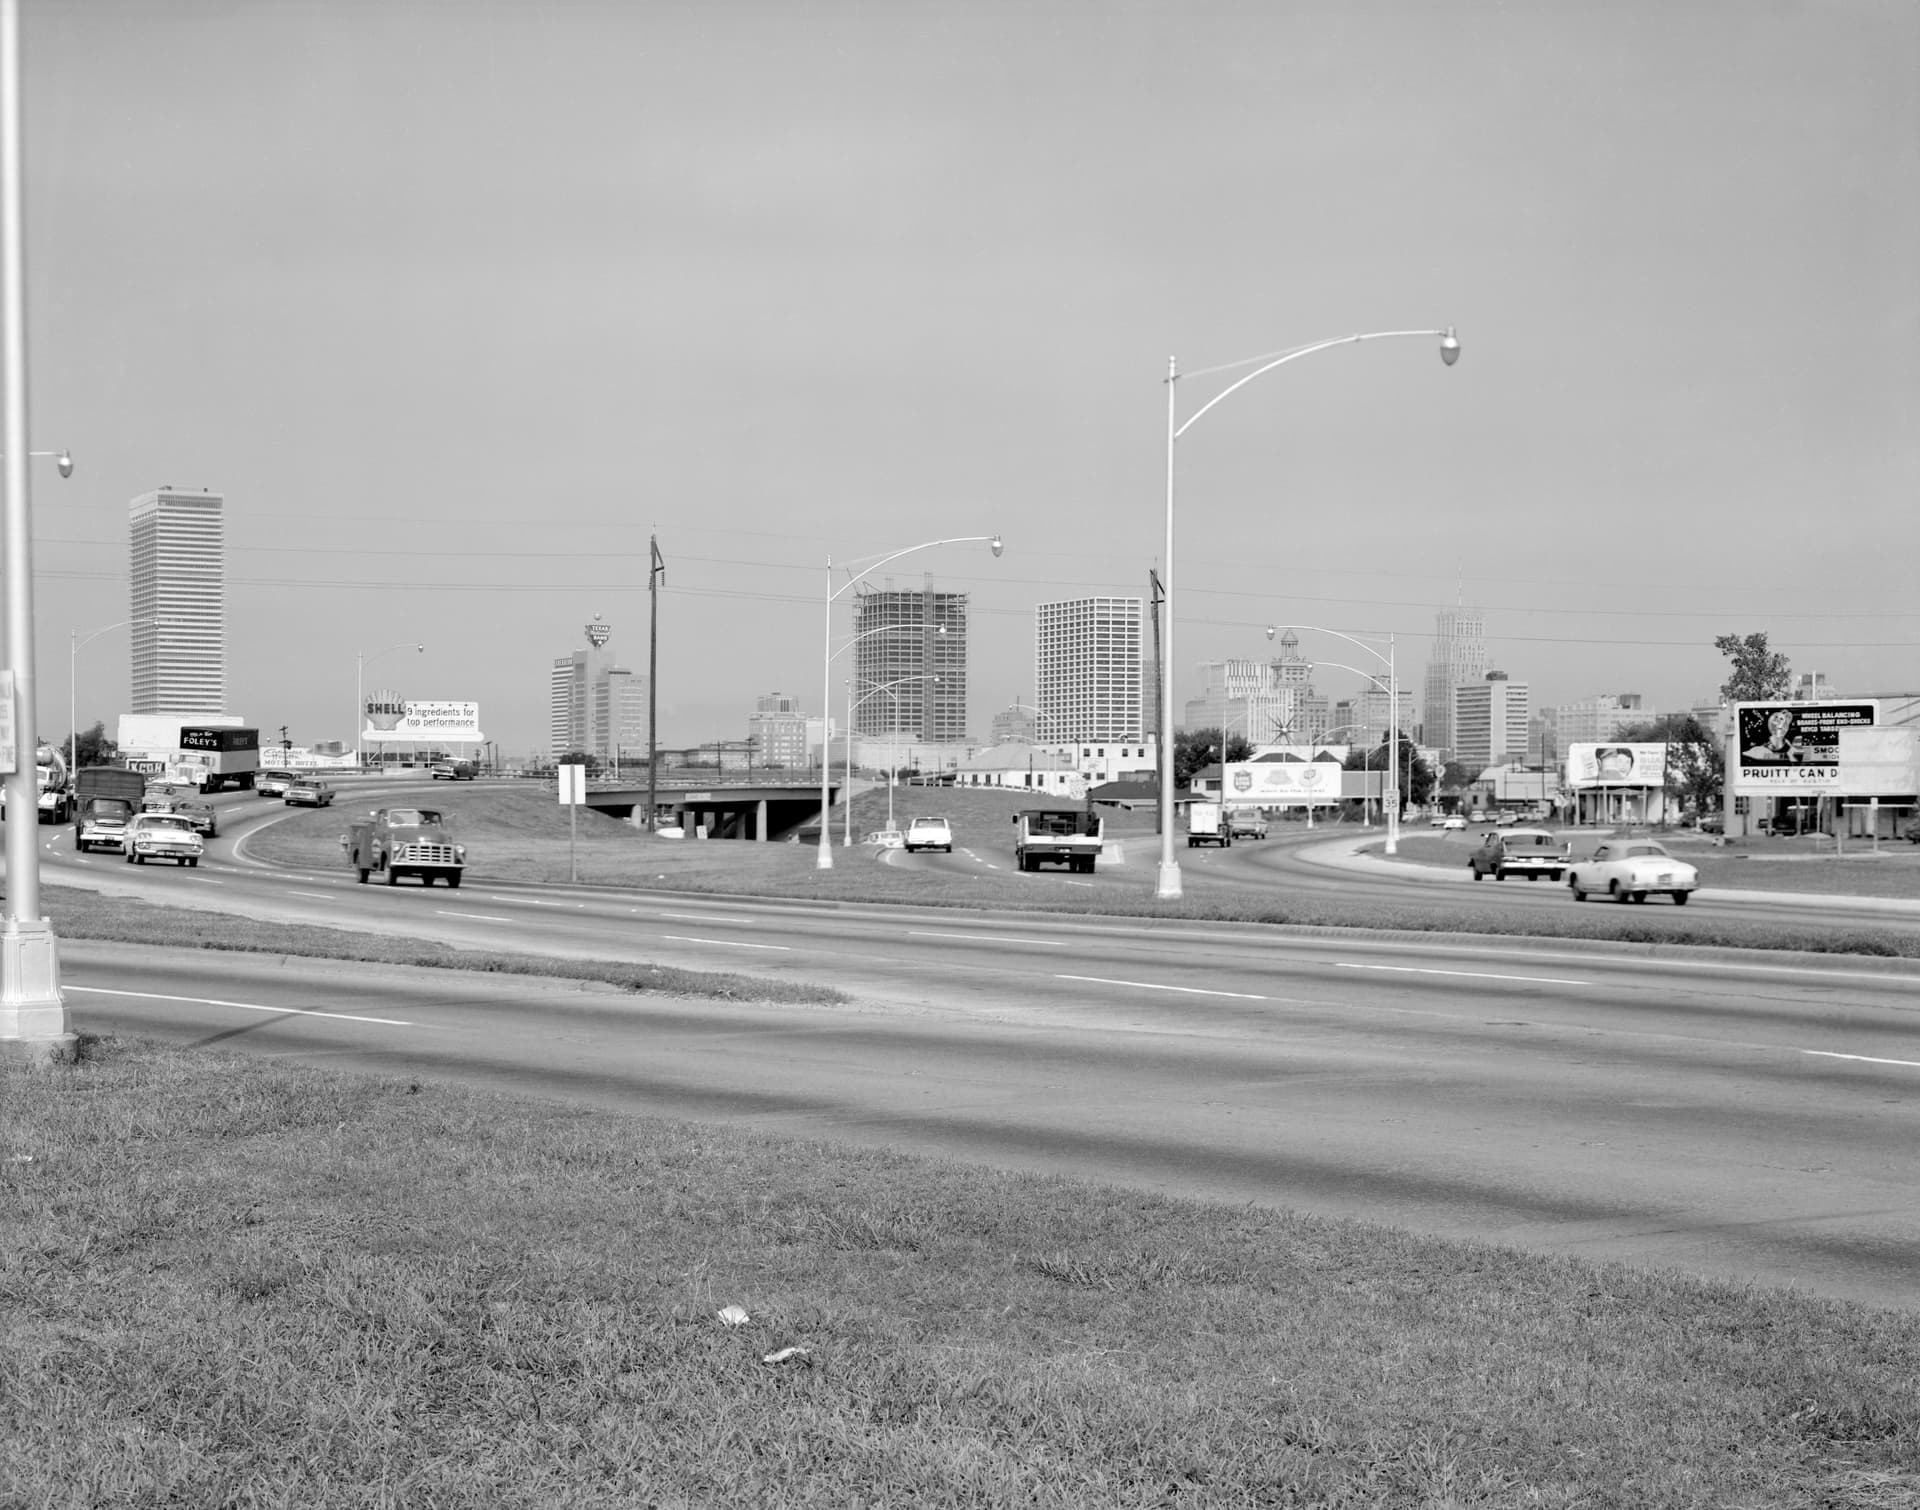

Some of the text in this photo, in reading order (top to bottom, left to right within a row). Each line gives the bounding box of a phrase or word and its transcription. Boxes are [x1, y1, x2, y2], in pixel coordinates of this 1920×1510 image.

[367, 703, 405, 715] SHELL
[407, 707, 475, 718] 9 ingredients for
[407, 718, 475, 728] top performance
[183, 737, 217, 747] FOLEY'S
[1743, 769, 1838, 778] PRUITT CAN D
[1385, 799, 1397, 808] 35
